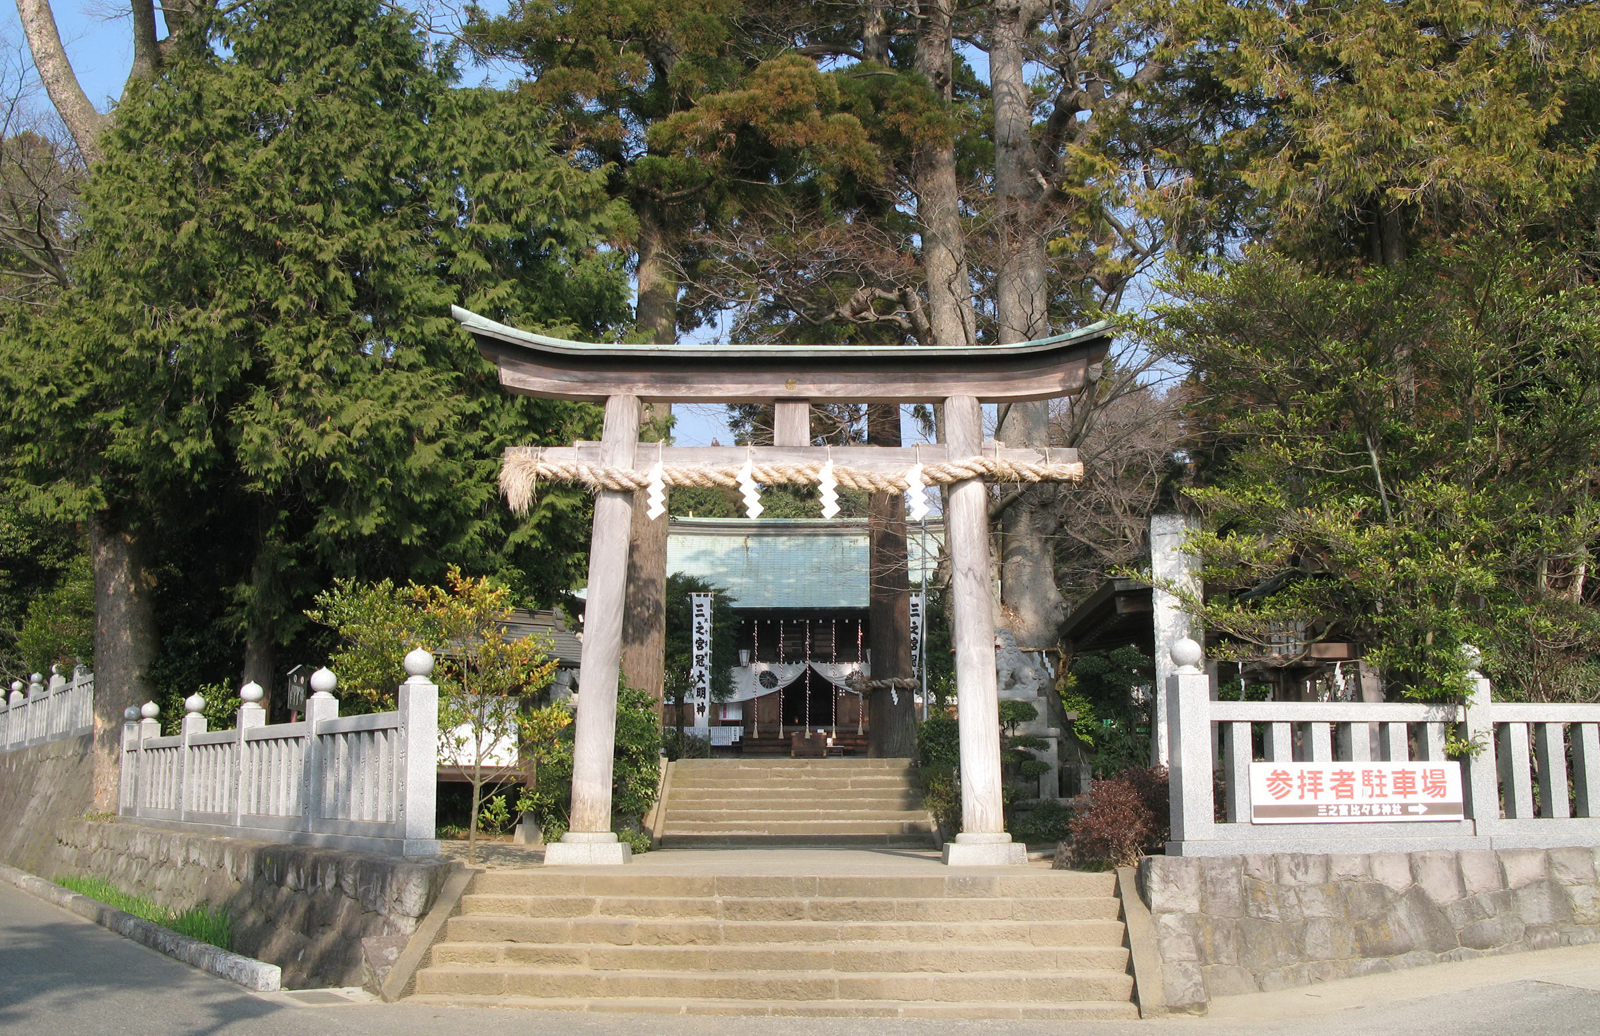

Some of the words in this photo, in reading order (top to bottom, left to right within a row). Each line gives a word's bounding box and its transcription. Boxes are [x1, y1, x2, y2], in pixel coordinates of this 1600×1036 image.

[695, 603, 706, 717] 三之宮冠大明神
[1266, 768, 1447, 800] 参拝者駐車場
